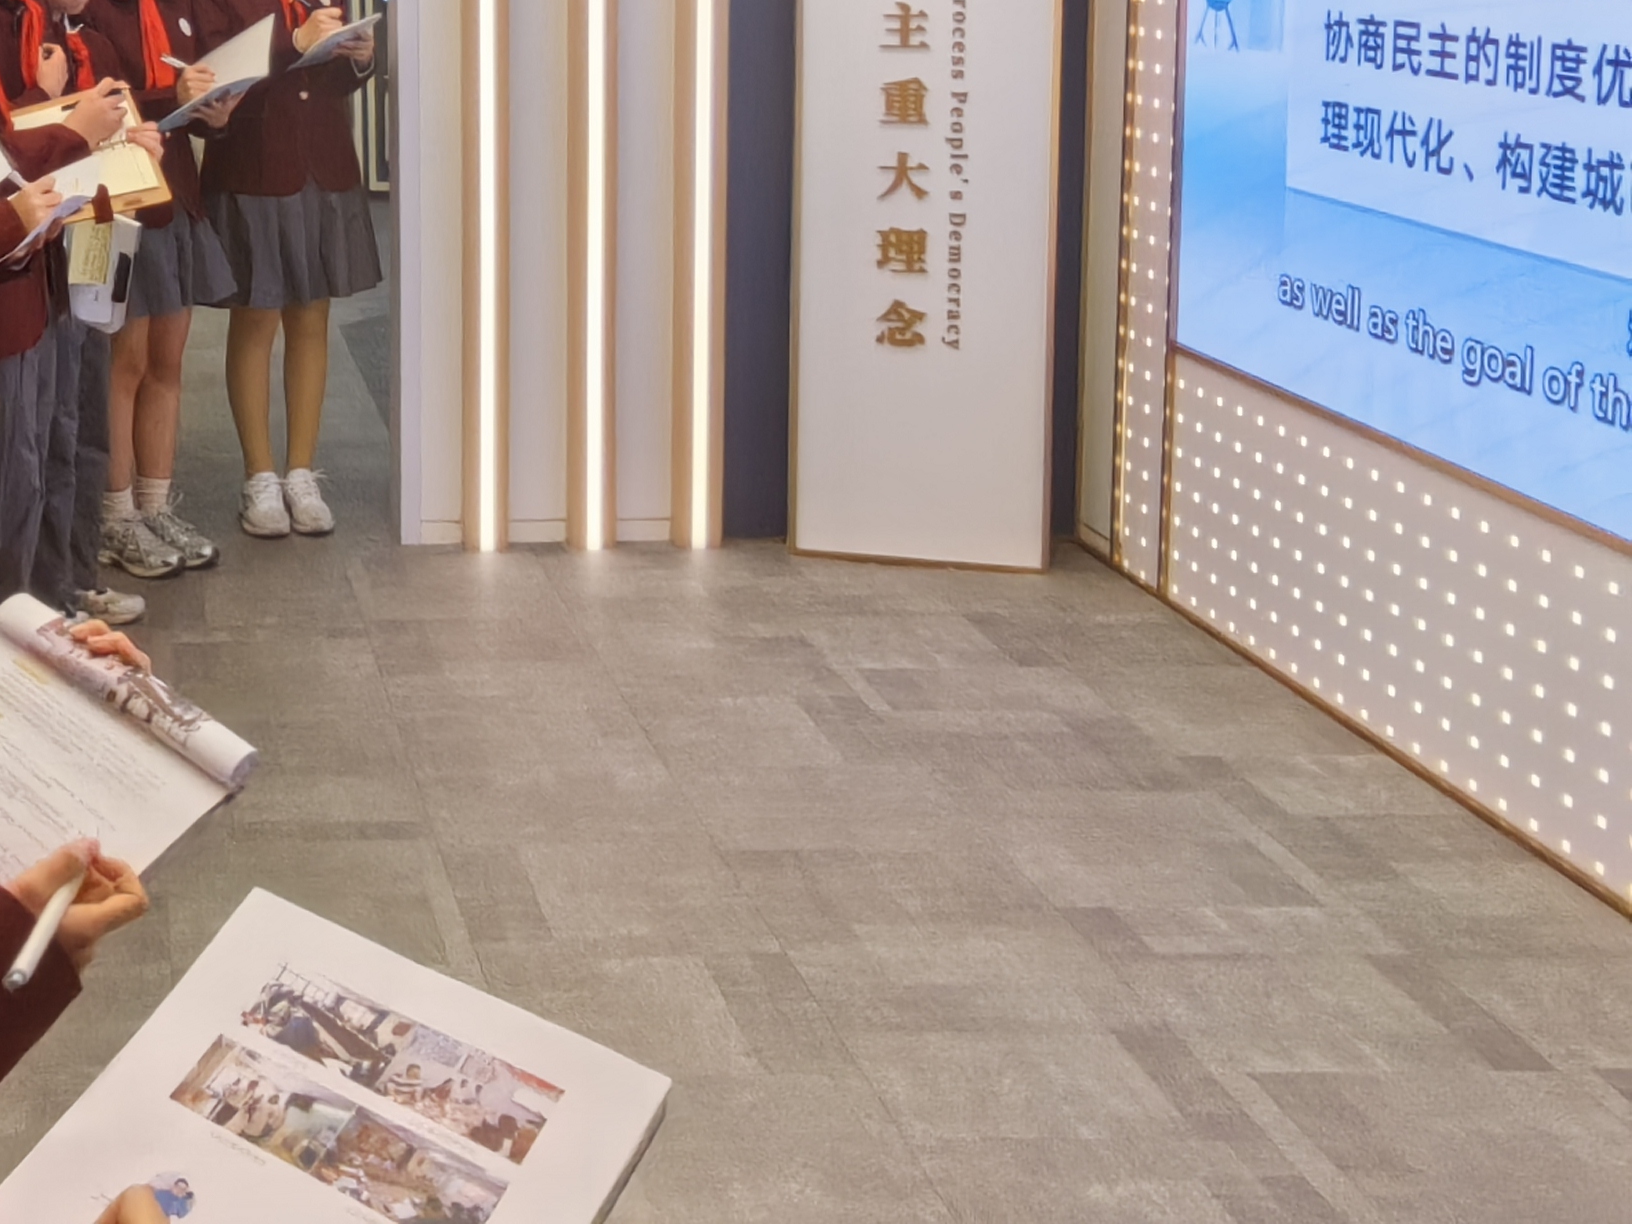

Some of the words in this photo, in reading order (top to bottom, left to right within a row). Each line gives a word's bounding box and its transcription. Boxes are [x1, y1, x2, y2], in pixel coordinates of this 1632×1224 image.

[1320, 101, 1632, 217] 理现代化、构建城
[941, 212, 967, 351] Democracy
[1278, 274, 1305, 310] as
[1311, 283, 1361, 331] well
[1369, 306, 1398, 344] as
[1405, 309, 1455, 364] the
[1462, 337, 1534, 395] goal
[1543, 361, 1584, 412] of
